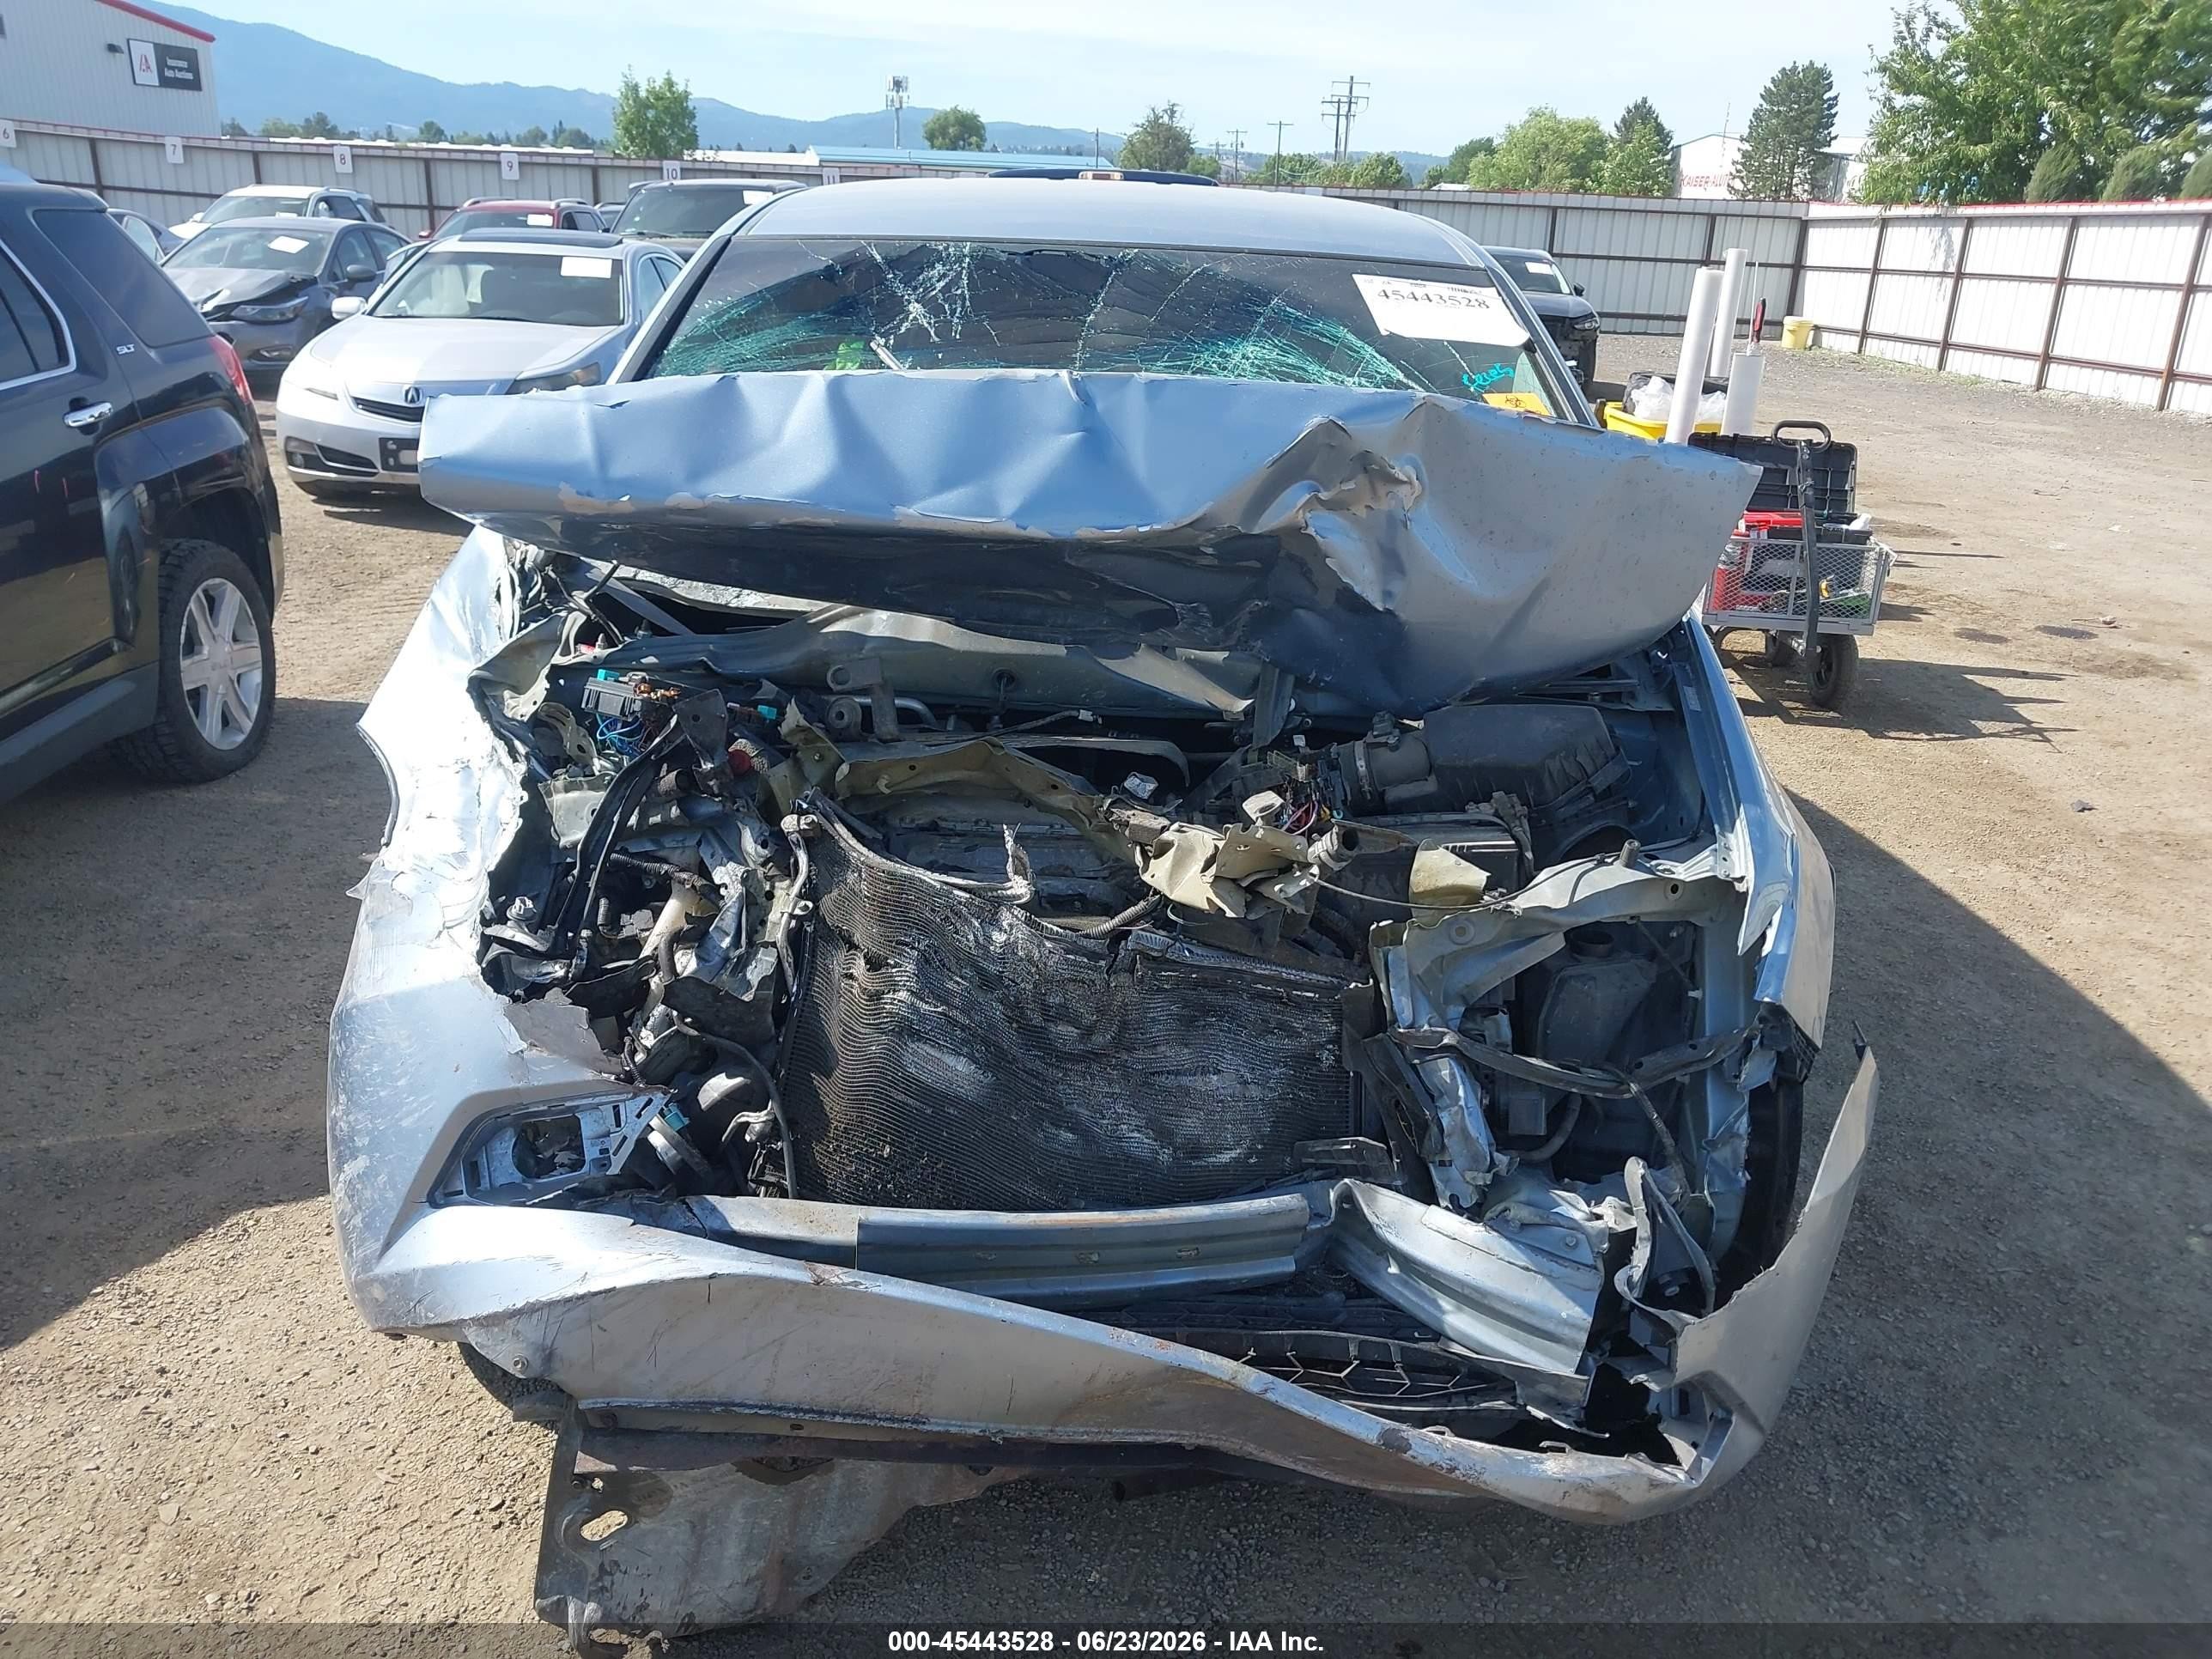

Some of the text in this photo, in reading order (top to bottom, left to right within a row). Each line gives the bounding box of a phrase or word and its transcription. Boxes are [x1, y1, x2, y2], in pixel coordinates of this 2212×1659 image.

[3, 127, 10, 140] 6
[169, 143, 177, 156] 7
[339, 153, 346, 166] 8
[507, 160, 514, 172] 9
[666, 167, 678, 179] 10
[827, 174, 836, 185] 11
[1377, 289, 1490, 309] 45443528
[116, 343, 135, 355] SLT
